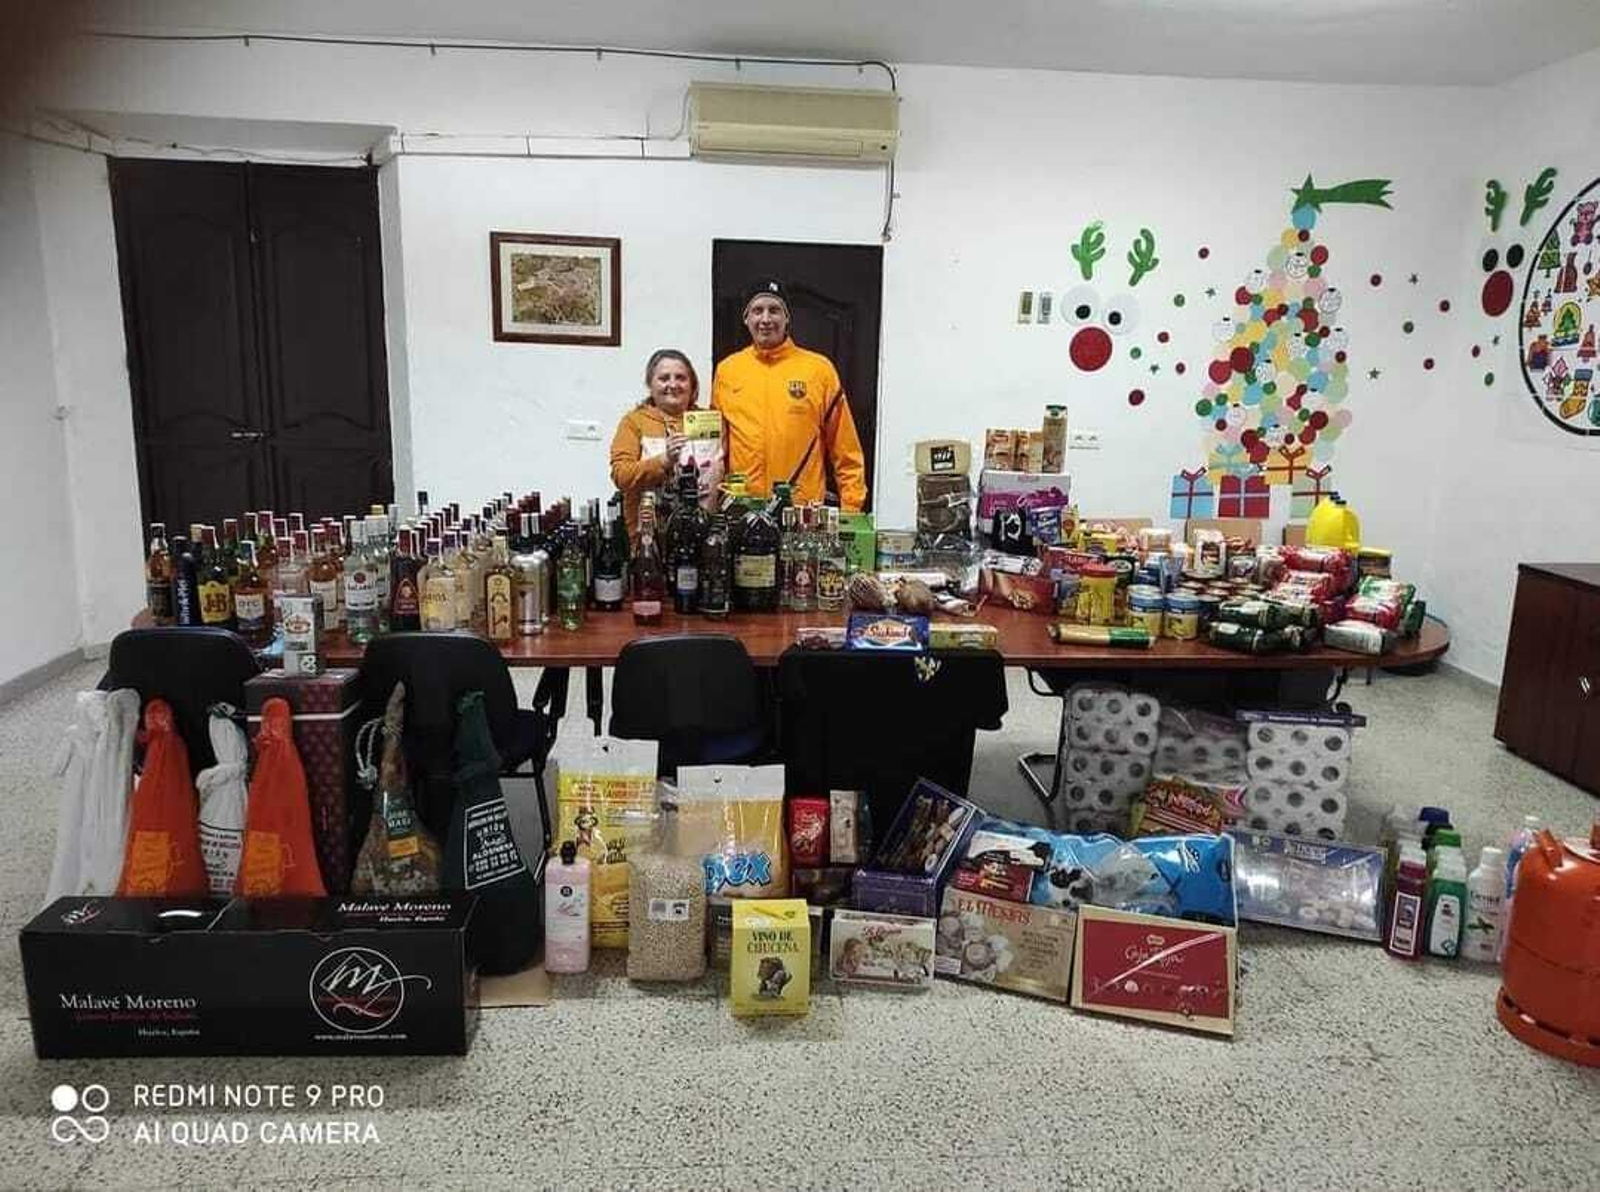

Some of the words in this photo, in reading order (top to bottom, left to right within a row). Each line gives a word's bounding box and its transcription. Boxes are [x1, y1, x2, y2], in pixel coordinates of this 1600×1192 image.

[337, 902, 391, 912] Malavé
[393, 902, 452, 912] Moreno
[59, 993, 121, 1009] Malavé
[125, 993, 199, 1009] Moreno
